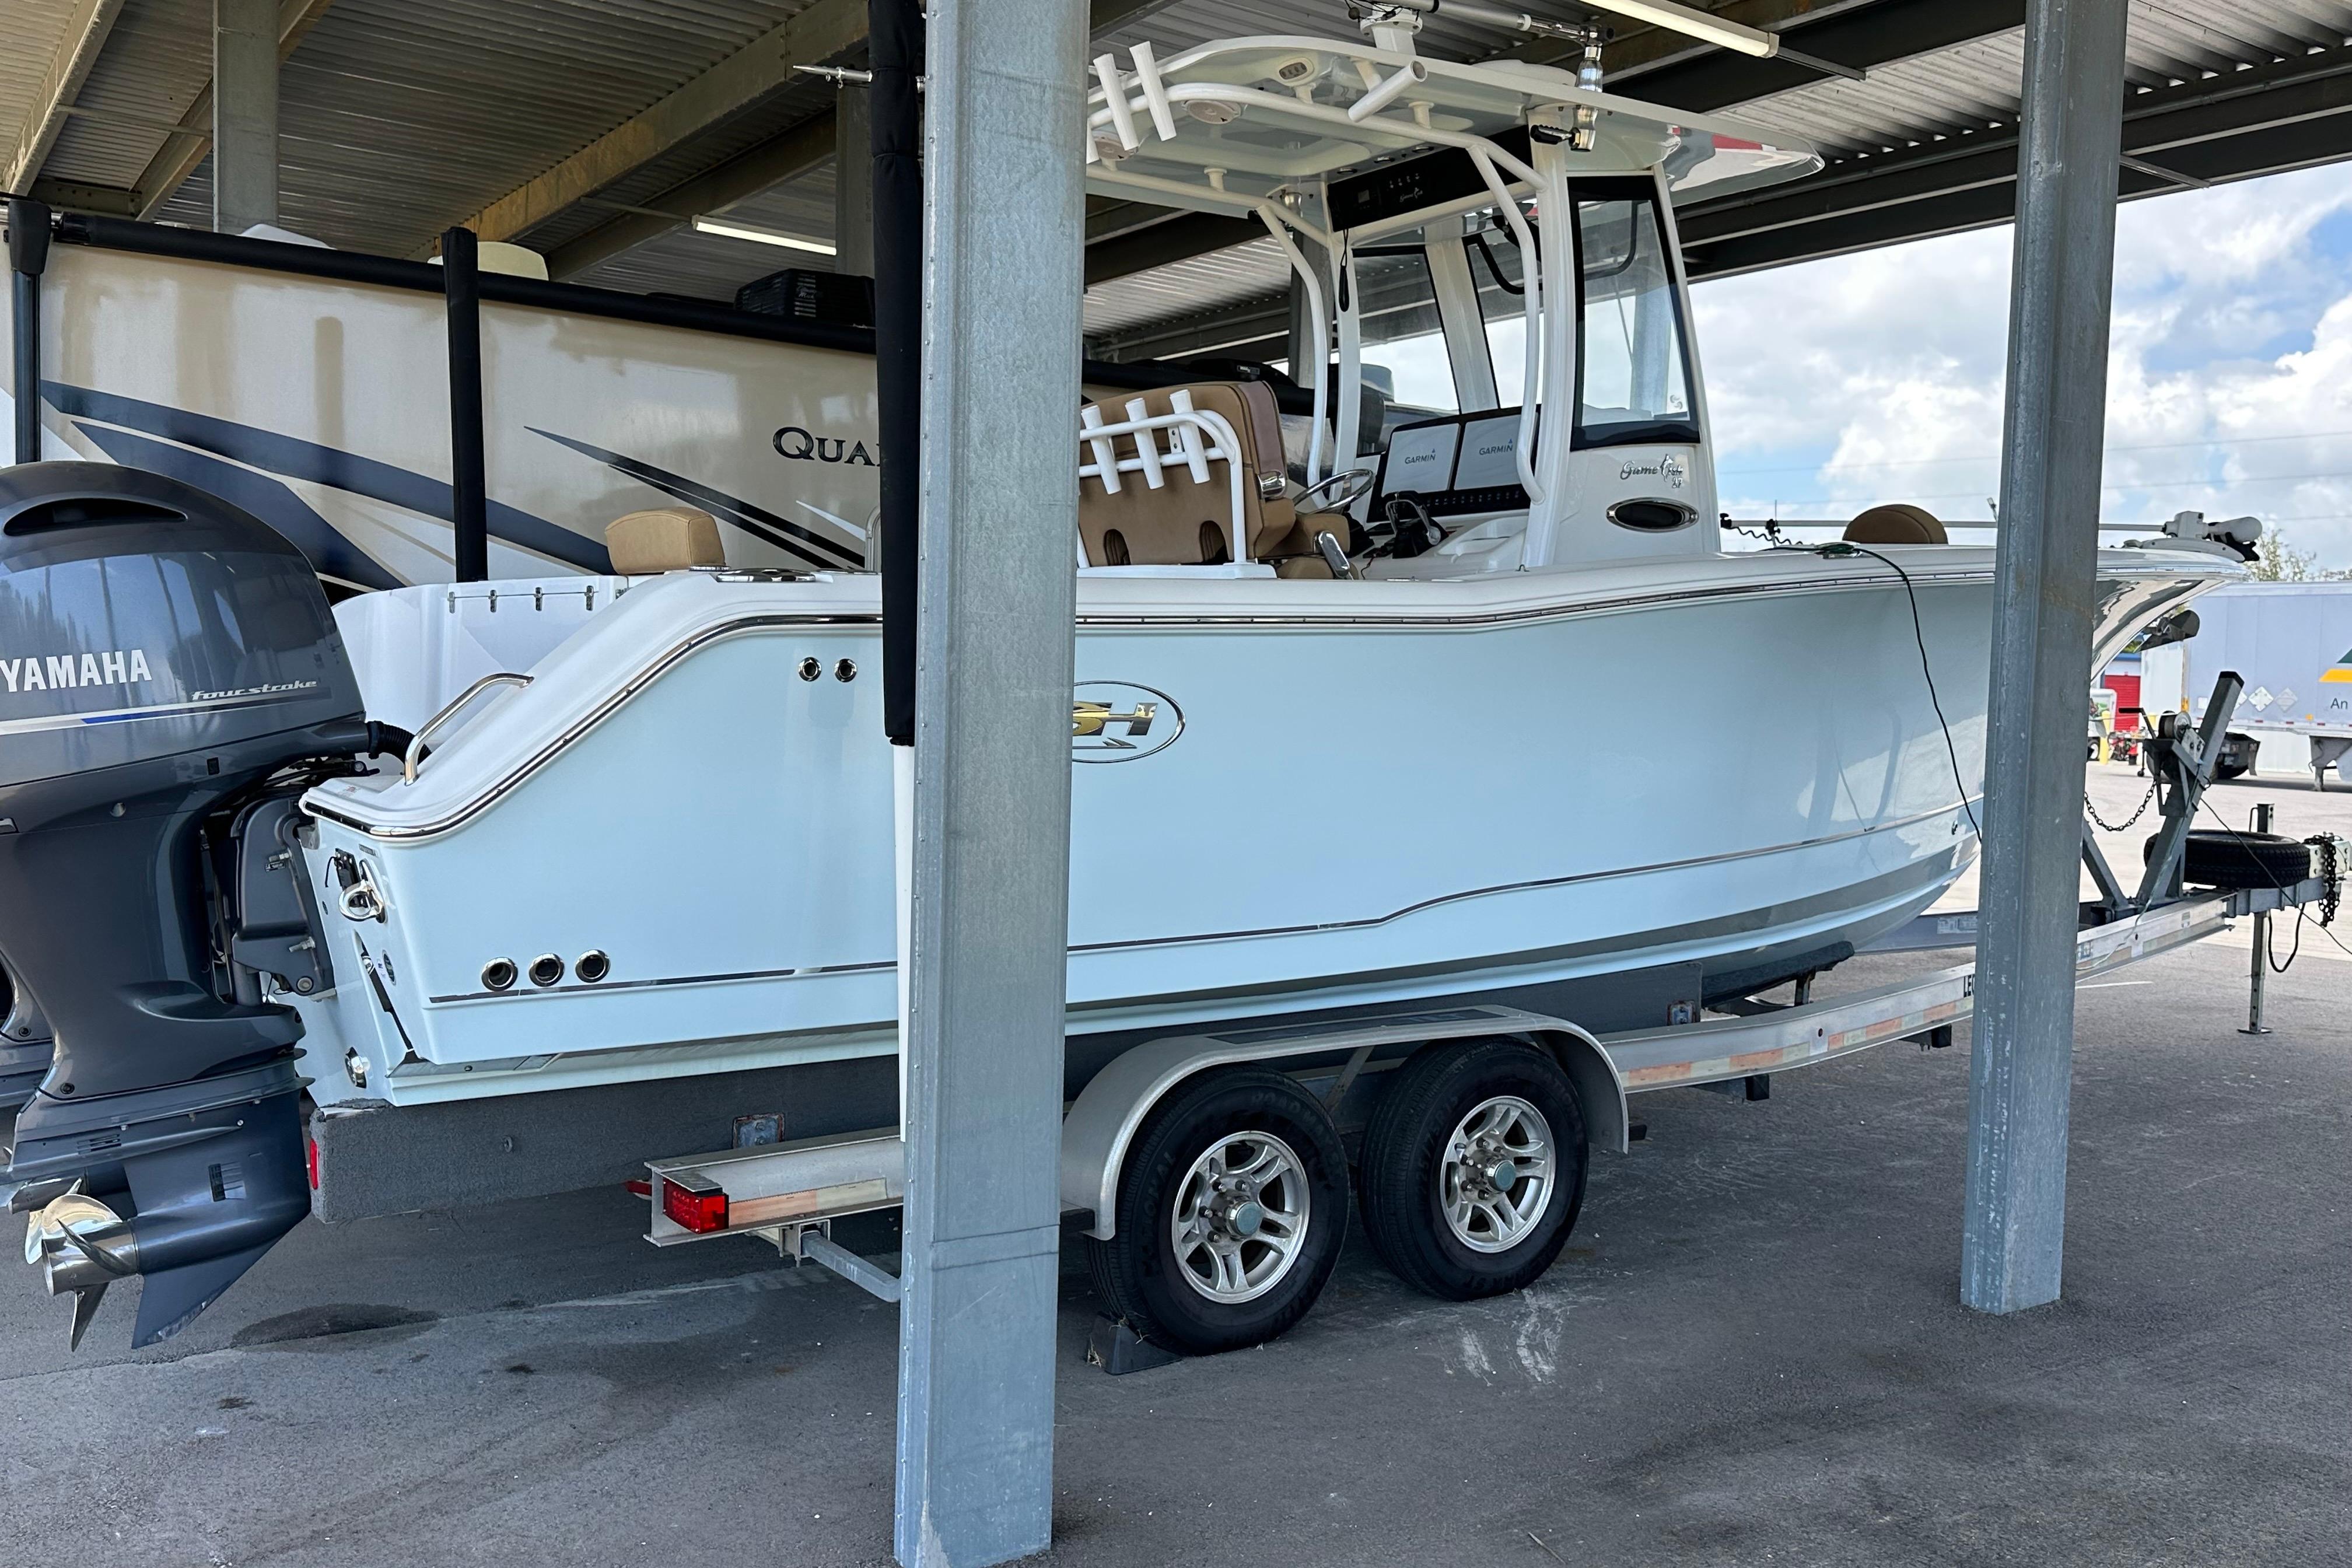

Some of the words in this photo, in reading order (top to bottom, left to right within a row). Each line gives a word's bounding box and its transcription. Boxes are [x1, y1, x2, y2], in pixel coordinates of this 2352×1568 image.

[773, 427, 880, 467] QUA
[1479, 444, 1513, 455] GARMIN
[1405, 453, 1436, 464] GARMIN
[1620, 460, 1658, 480] Game
[1671, 476, 1683, 489] 27
[0, 649, 152, 692] YAMAHA
[2330, 698, 2348, 709] An
